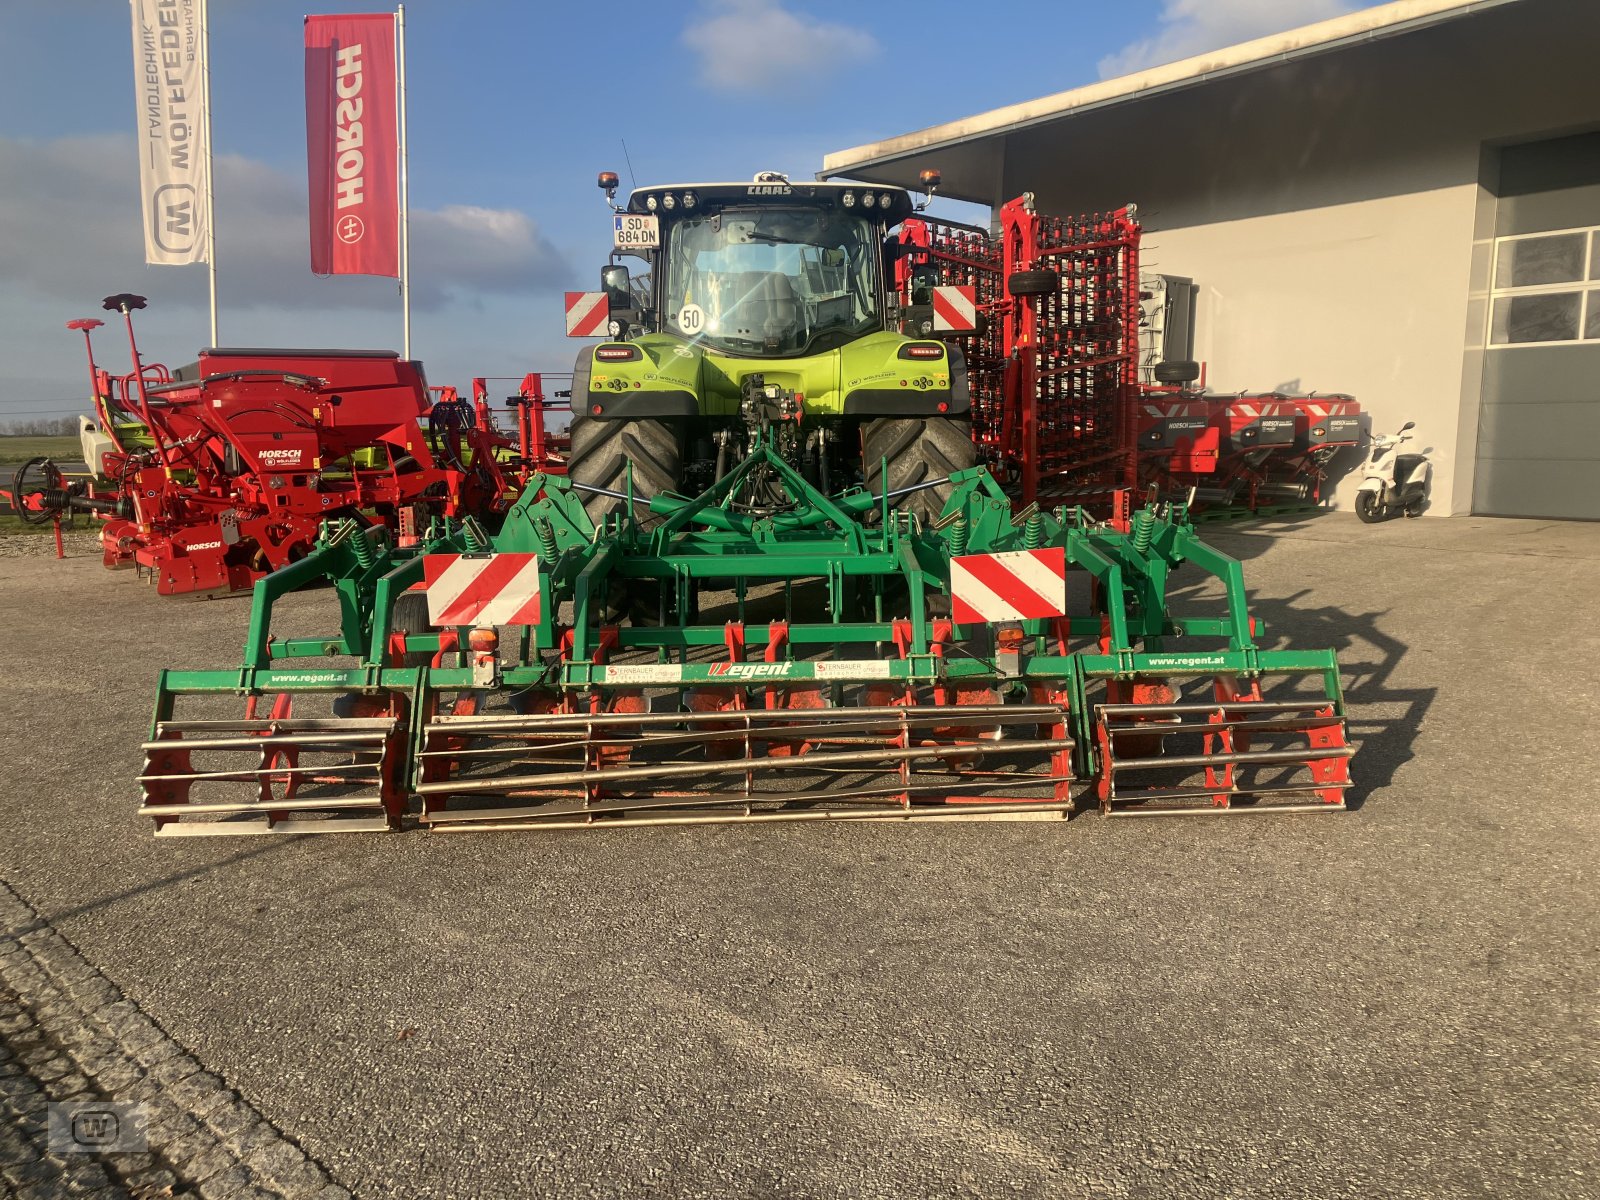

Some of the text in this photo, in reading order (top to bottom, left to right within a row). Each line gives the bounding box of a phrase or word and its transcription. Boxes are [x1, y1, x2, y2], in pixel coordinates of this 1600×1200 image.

[747, 186, 792, 195] CLAAS
[627, 218, 642, 230] SD
[618, 231, 656, 243] 684 DN
[683, 310, 699, 328] 50
[258, 449, 302, 459] HORSCH
[186, 541, 221, 552] HORSCH
[1148, 656, 1225, 666] www.regent.at
[707, 661, 793, 679] Regent
[271, 674, 347, 683] www.regent.at
